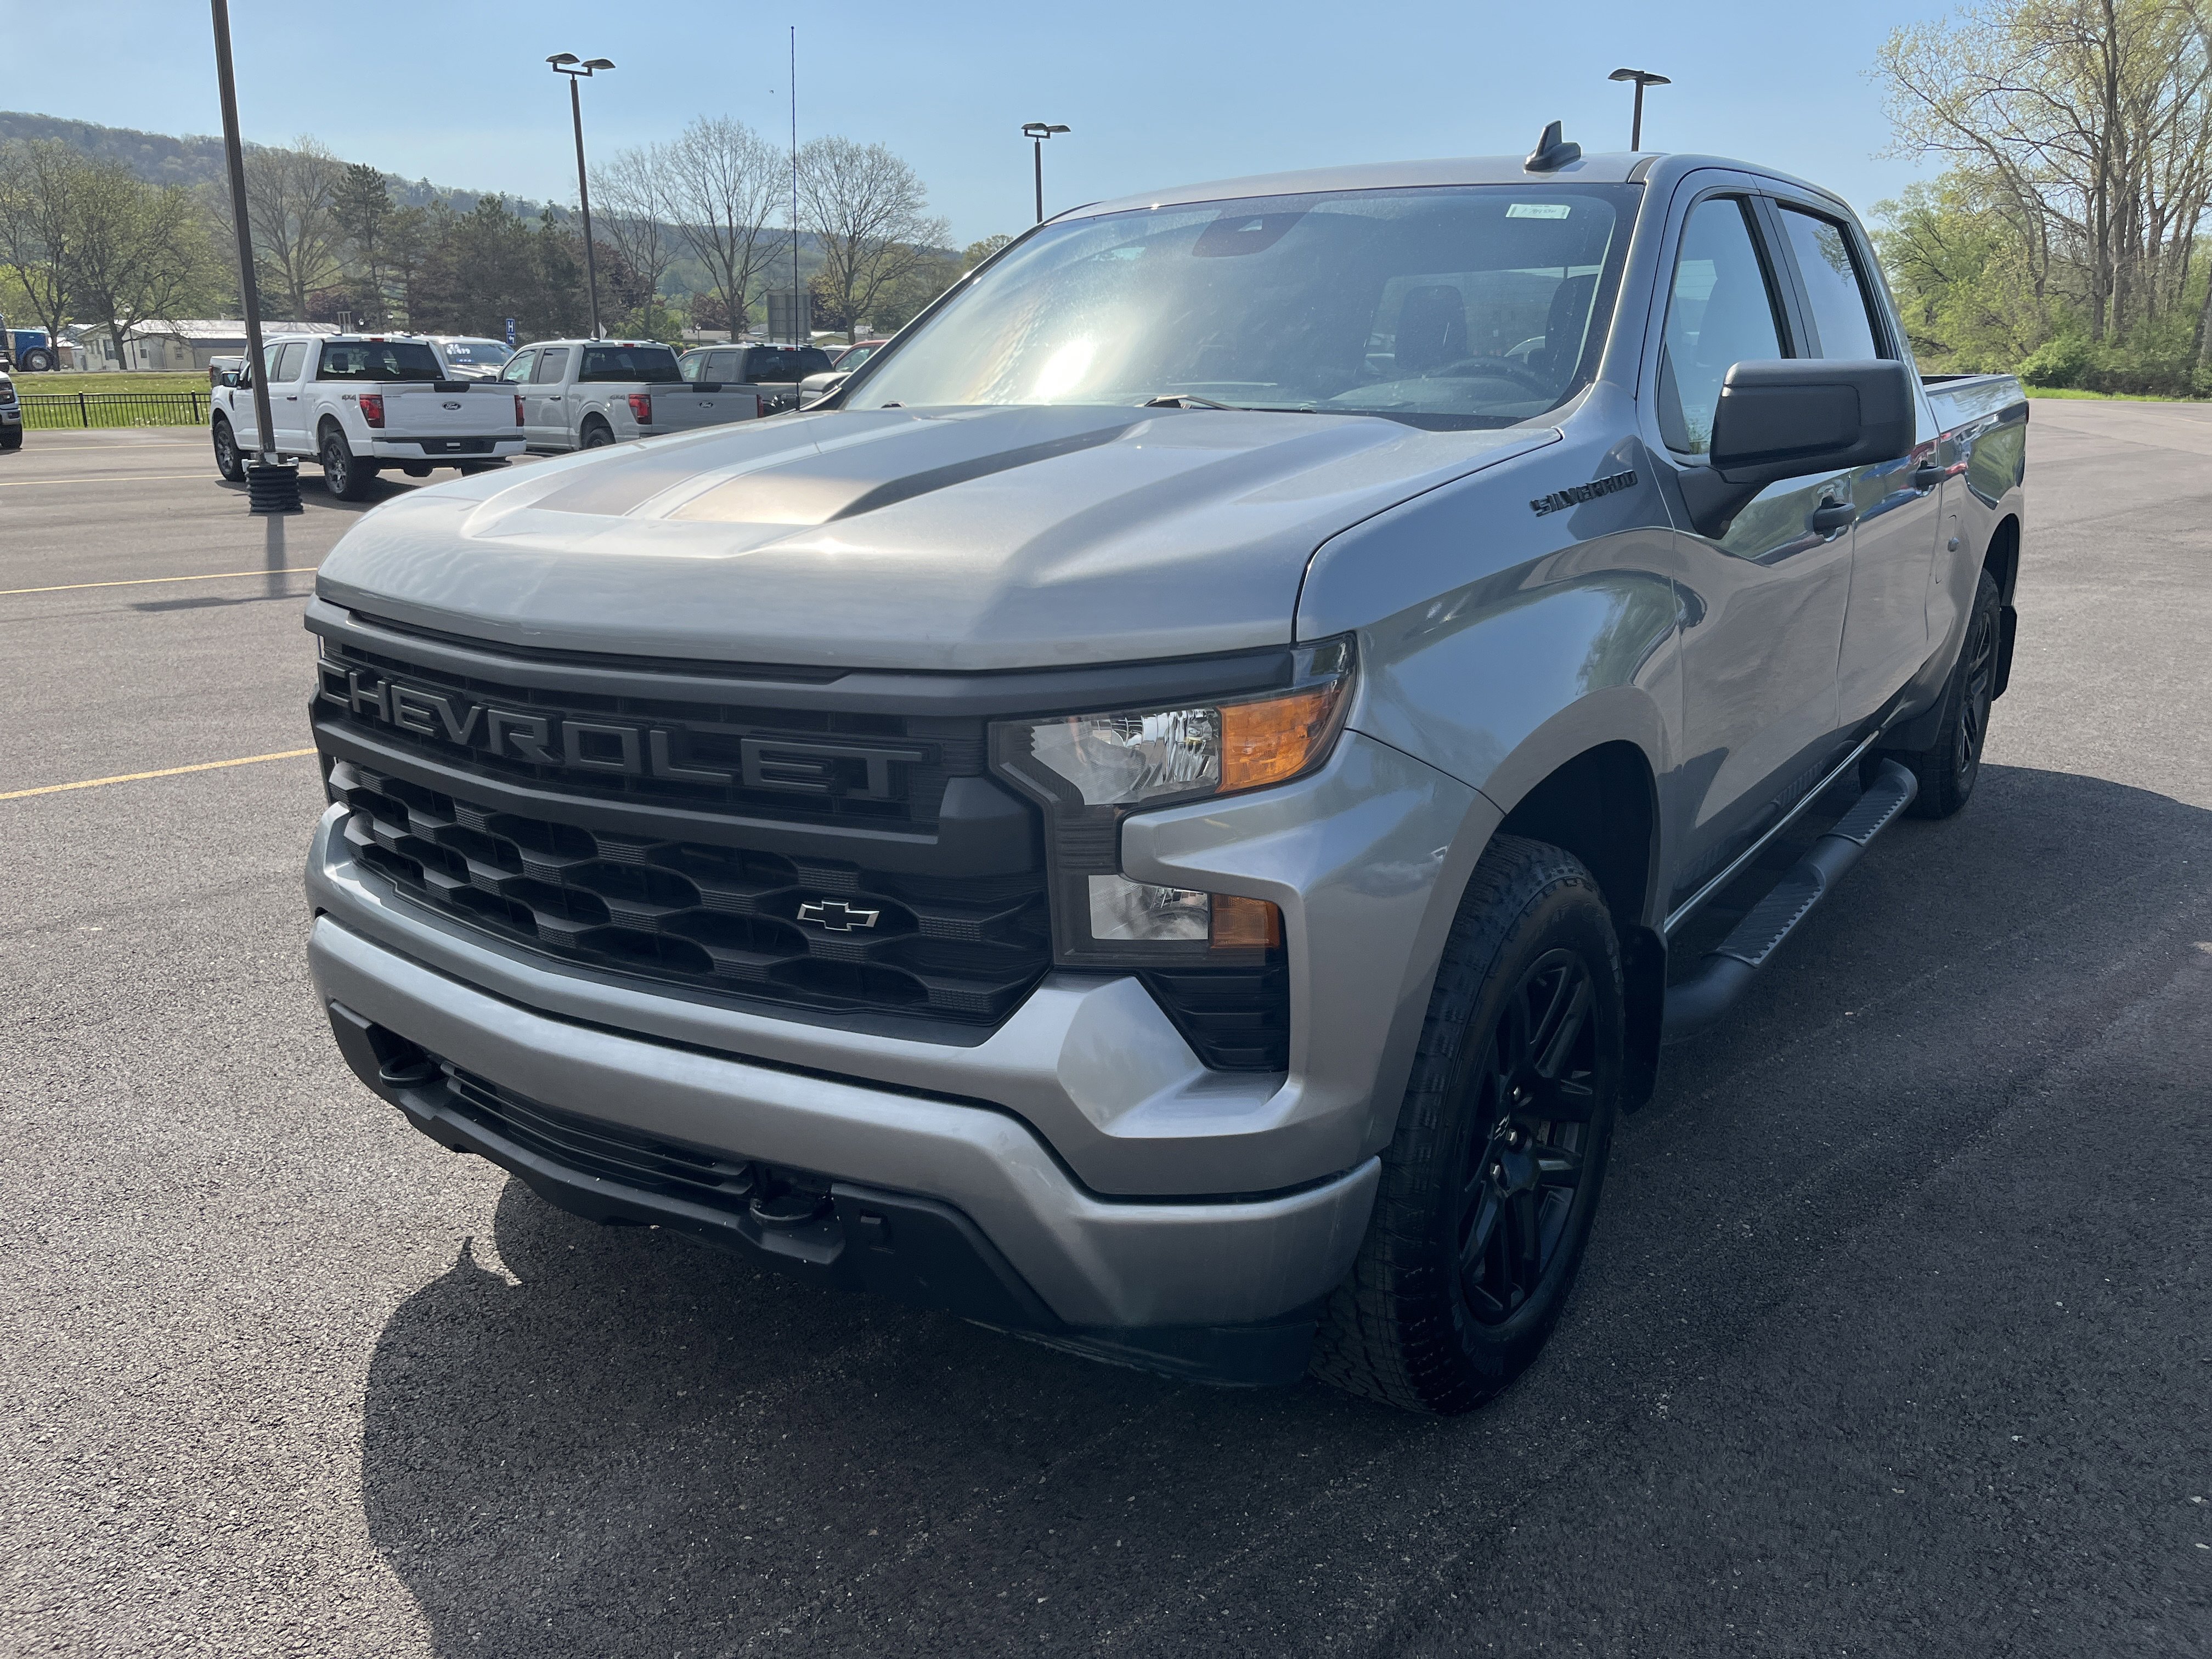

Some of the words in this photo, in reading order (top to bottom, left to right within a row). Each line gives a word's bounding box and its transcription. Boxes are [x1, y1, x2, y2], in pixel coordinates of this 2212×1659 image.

[507, 321, 514, 332] H
[1529, 469, 1638, 517] SILVERADO
[318, 659, 930, 799] CHEVROLET
